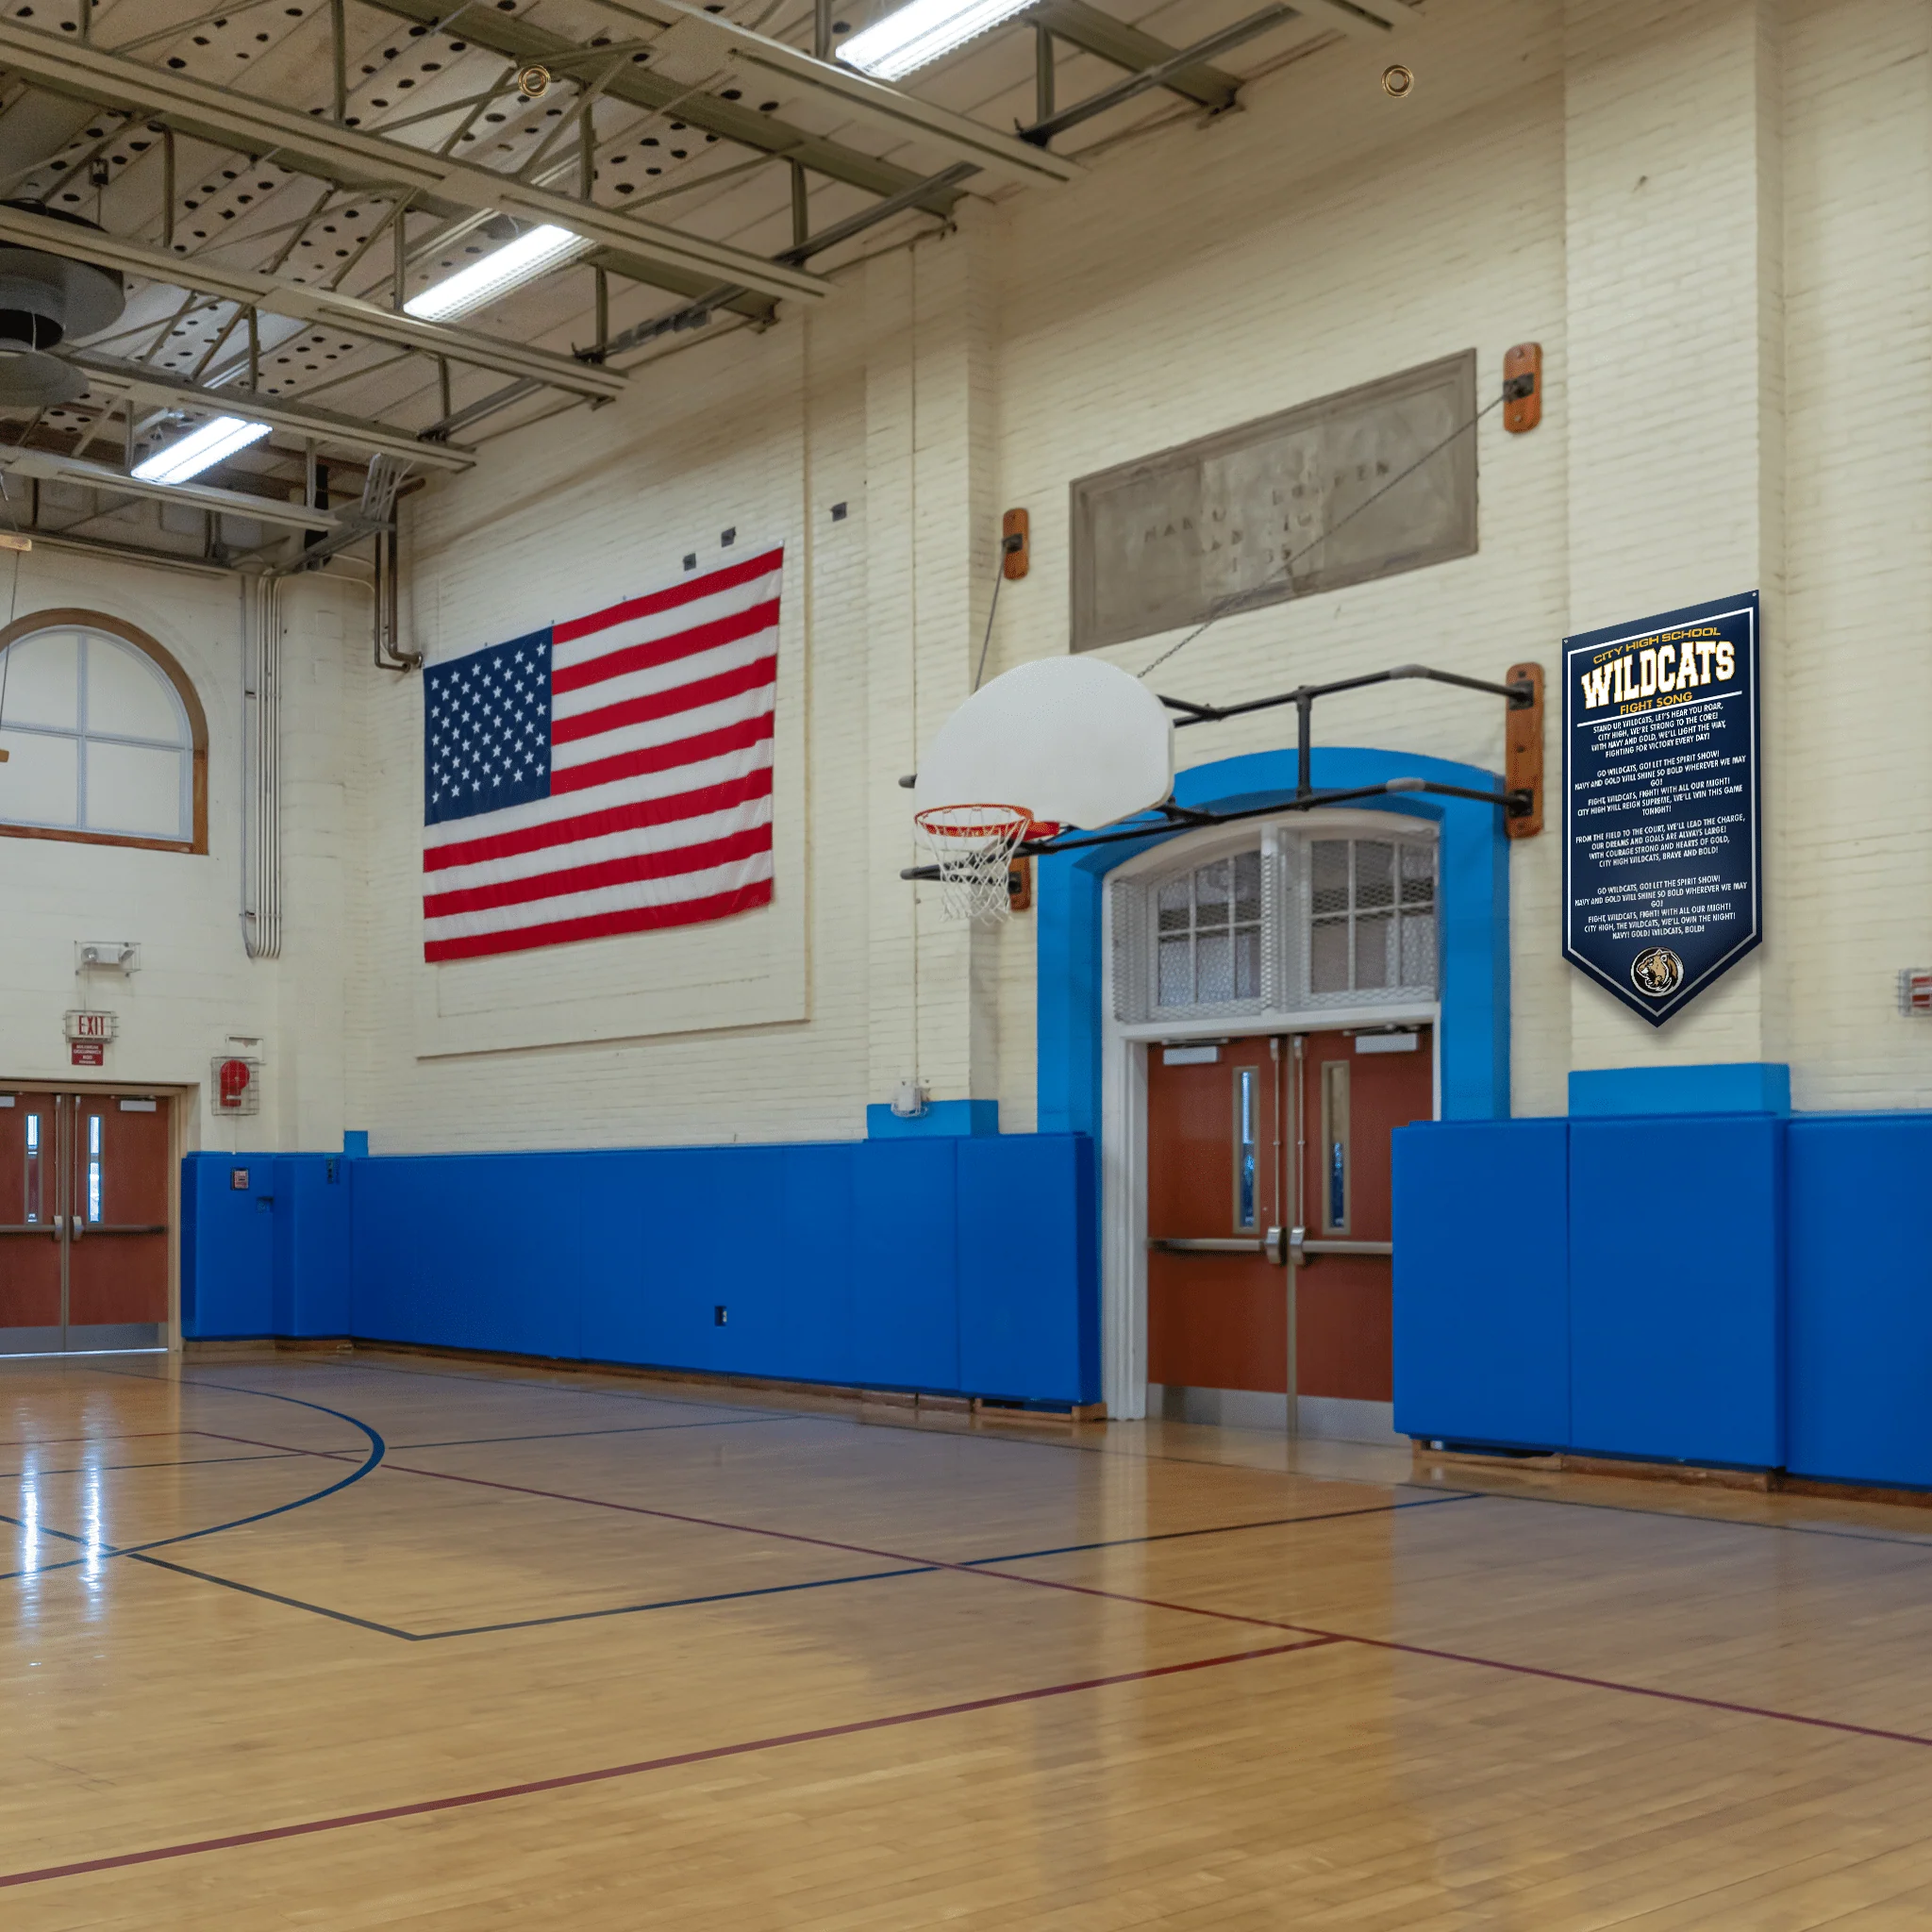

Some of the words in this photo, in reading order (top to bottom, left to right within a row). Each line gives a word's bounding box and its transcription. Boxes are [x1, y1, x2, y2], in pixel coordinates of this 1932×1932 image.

[1593, 647, 1623, 664] CITY
[1625, 636, 1659, 652] HIGH
[1661, 626, 1721, 642] SCHOOL
[1581, 641, 1736, 709] WILDCATS
[1620, 700, 1654, 715] FIGHT
[1656, 691, 1693, 708] SONG
[1593, 724, 1612, 734] STAND
[1671, 708, 1688, 719] HEAR
[1689, 706, 1703, 715] YOU
[1598, 733, 1611, 742] CITY
[1650, 720, 1674, 732] STRONG
[1676, 718, 1685, 727] TO
[1685, 716, 1698, 725] THE
[1591, 742, 1607, 753] WITH
[1607, 740, 1624, 749] NAVY
[1624, 737, 1638, 746] AND
[1677, 725, 1696, 737] LIGHT
[1697, 723, 1710, 733] THE
[1606, 746, 1634, 758] FIGHTING
[1636, 744, 1648, 753] FOR
[1648, 739, 1674, 751] VICTORY
[1674, 735, 1694, 746] EVERY
[1574, 781, 1590, 791] NAVY
[1591, 779, 1603, 789] AND
[1605, 776, 1621, 786] GOLD
[1622, 774, 1636, 783] WILL
[1637, 771, 1656, 780] SHINE
[1657, 769, 1665, 777] SO
[1667, 766, 1683, 775] BOLD
[1685, 759, 1719, 773] WHEREVER
[1720, 758, 1730, 767] WE
[1732, 755, 1746, 765] MAY
[1597, 770, 1607, 778] GO
[1652, 759, 1662, 769] LET
[1663, 758, 1675, 767] THE
[1676, 754, 1696, 765] SPIRIT
[1660, 785, 1677, 795] WITH
[1678, 783, 1690, 792] ALL
[1690, 781, 1705, 791] OUR
[1577, 808, 1590, 817] CITY
[1591, 806, 1606, 815] HIGH
[1607, 804, 1622, 812] WILL
[1622, 800, 1641, 810] REIGN
[1692, 790, 1707, 799] WIN
[1708, 788, 1723, 797] THIS
[1724, 784, 1742, 794] GAME
[1575, 835, 1591, 844] FROM
[1593, 833, 1604, 841] THE
[1606, 831, 1622, 840] FIELD
[1623, 829, 1631, 838] TO
[1632, 827, 1643, 837] THE
[1687, 819, 1702, 828] LEAD
[1703, 817, 1715, 826] THE
[1591, 842, 1604, 851] OUR
[1606, 839, 1629, 849] DREAMS
[1630, 837, 1643, 846] AND
[1644, 834, 1665, 844] GOALS
[1665, 832, 1677, 841] ARE
[1678, 828, 1703, 840] ALWAYS
[1589, 852, 1604, 860] WITH
[1606, 848, 1634, 858] COURAGE
[1635, 844, 1659, 855] STRONG
[1660, 842, 1674, 852] AND
[1675, 839, 1699, 849] HEARTS
[1700, 838, 1708, 846] OF
[1599, 859, 1611, 868] CITY
[1613, 858, 1628, 867] HIGH
[1662, 851, 1681, 860] BRAVE
[1683, 848, 1697, 858] AND
[1574, 898, 1590, 908] NAVY
[1591, 897, 1603, 906] AND
[1605, 895, 1621, 904] GOLD
[1622, 893, 1637, 902] WILL
[1638, 891, 1656, 901] SHINE
[1667, 889, 1684, 897] BOLD
[1685, 884, 1720, 895] WHEREVER
[1721, 883, 1731, 891] WE
[1733, 881, 1747, 891] MAY
[1597, 888, 1607, 896] GO
[1653, 881, 1663, 890] LET
[1664, 880, 1676, 889] THE
[1676, 877, 1697, 887] SPIRIT
[1660, 908, 1678, 917] WITH
[1678, 907, 1690, 915] ALL
[1691, 905, 1706, 914] OUR
[1584, 924, 1597, 933] CITY
[1616, 922, 1627, 930] THE
[1680, 915, 1697, 924] OWN
[1698, 914, 1711, 923] THE
[79, 1016, 104, 1035] EXIT
